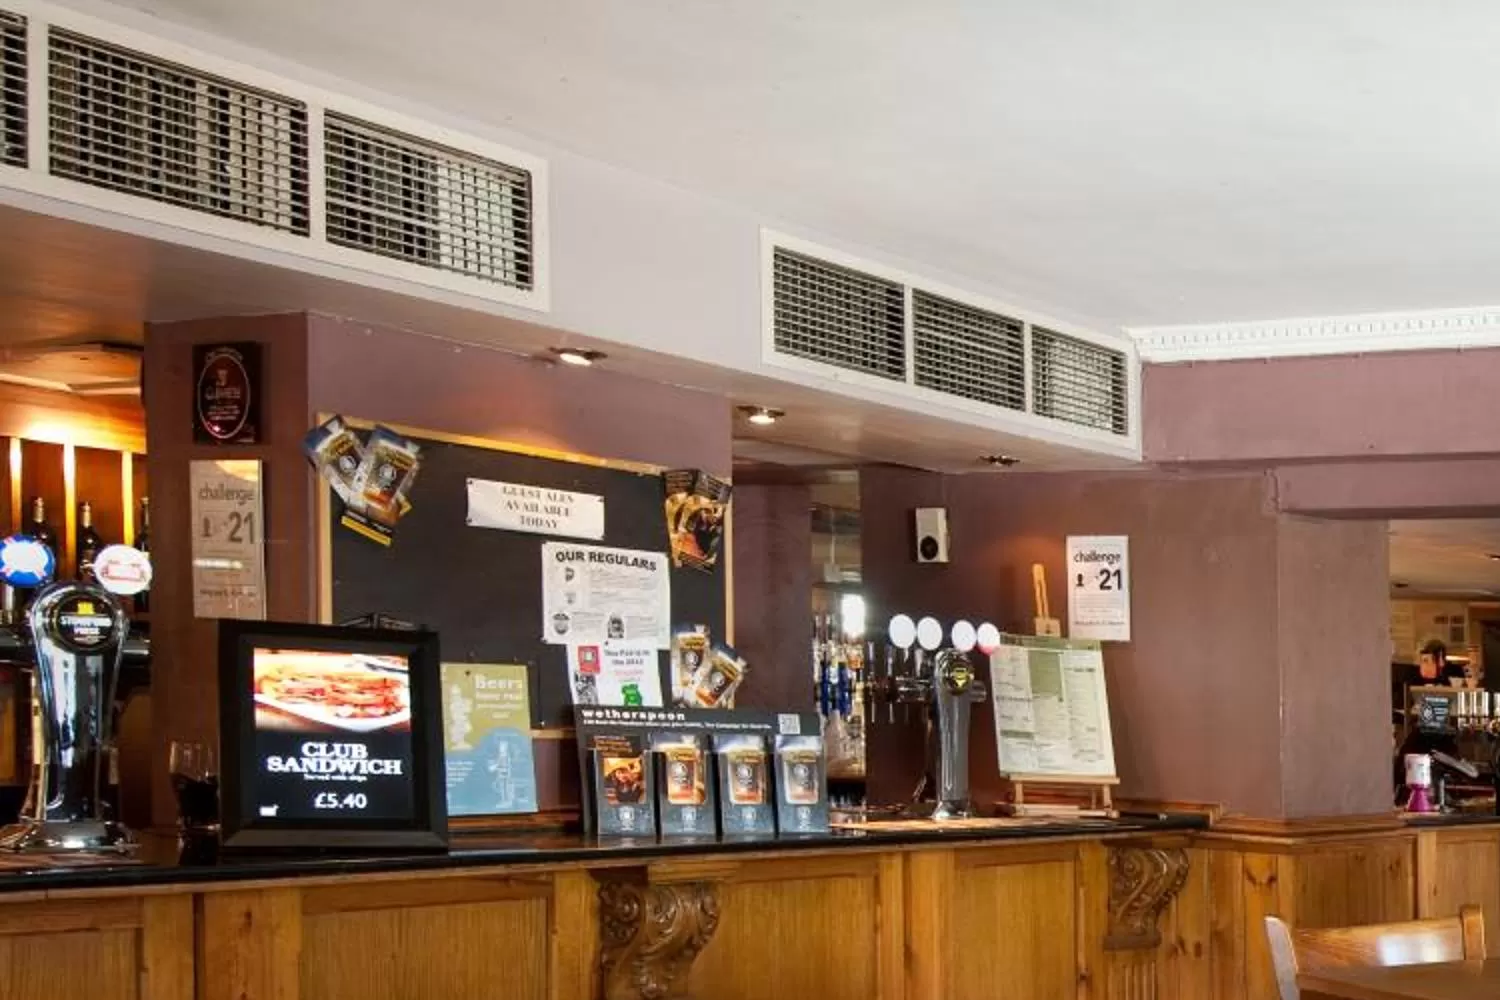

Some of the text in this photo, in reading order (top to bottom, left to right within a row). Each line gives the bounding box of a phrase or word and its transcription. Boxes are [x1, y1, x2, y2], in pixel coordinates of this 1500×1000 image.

[199, 482, 255, 506] challenge
[228, 511, 255, 545] 21
[555, 551, 657, 571] OUR REGULARS
[1074, 550, 1121, 565] challenge
[1099, 568, 1122, 591] 21
[582, 709, 685, 721] wetherspoon
[301, 741, 368, 759] CLUB
[266, 756, 403, 775] SANDWICH
[314, 792, 368, 809] £5.40
